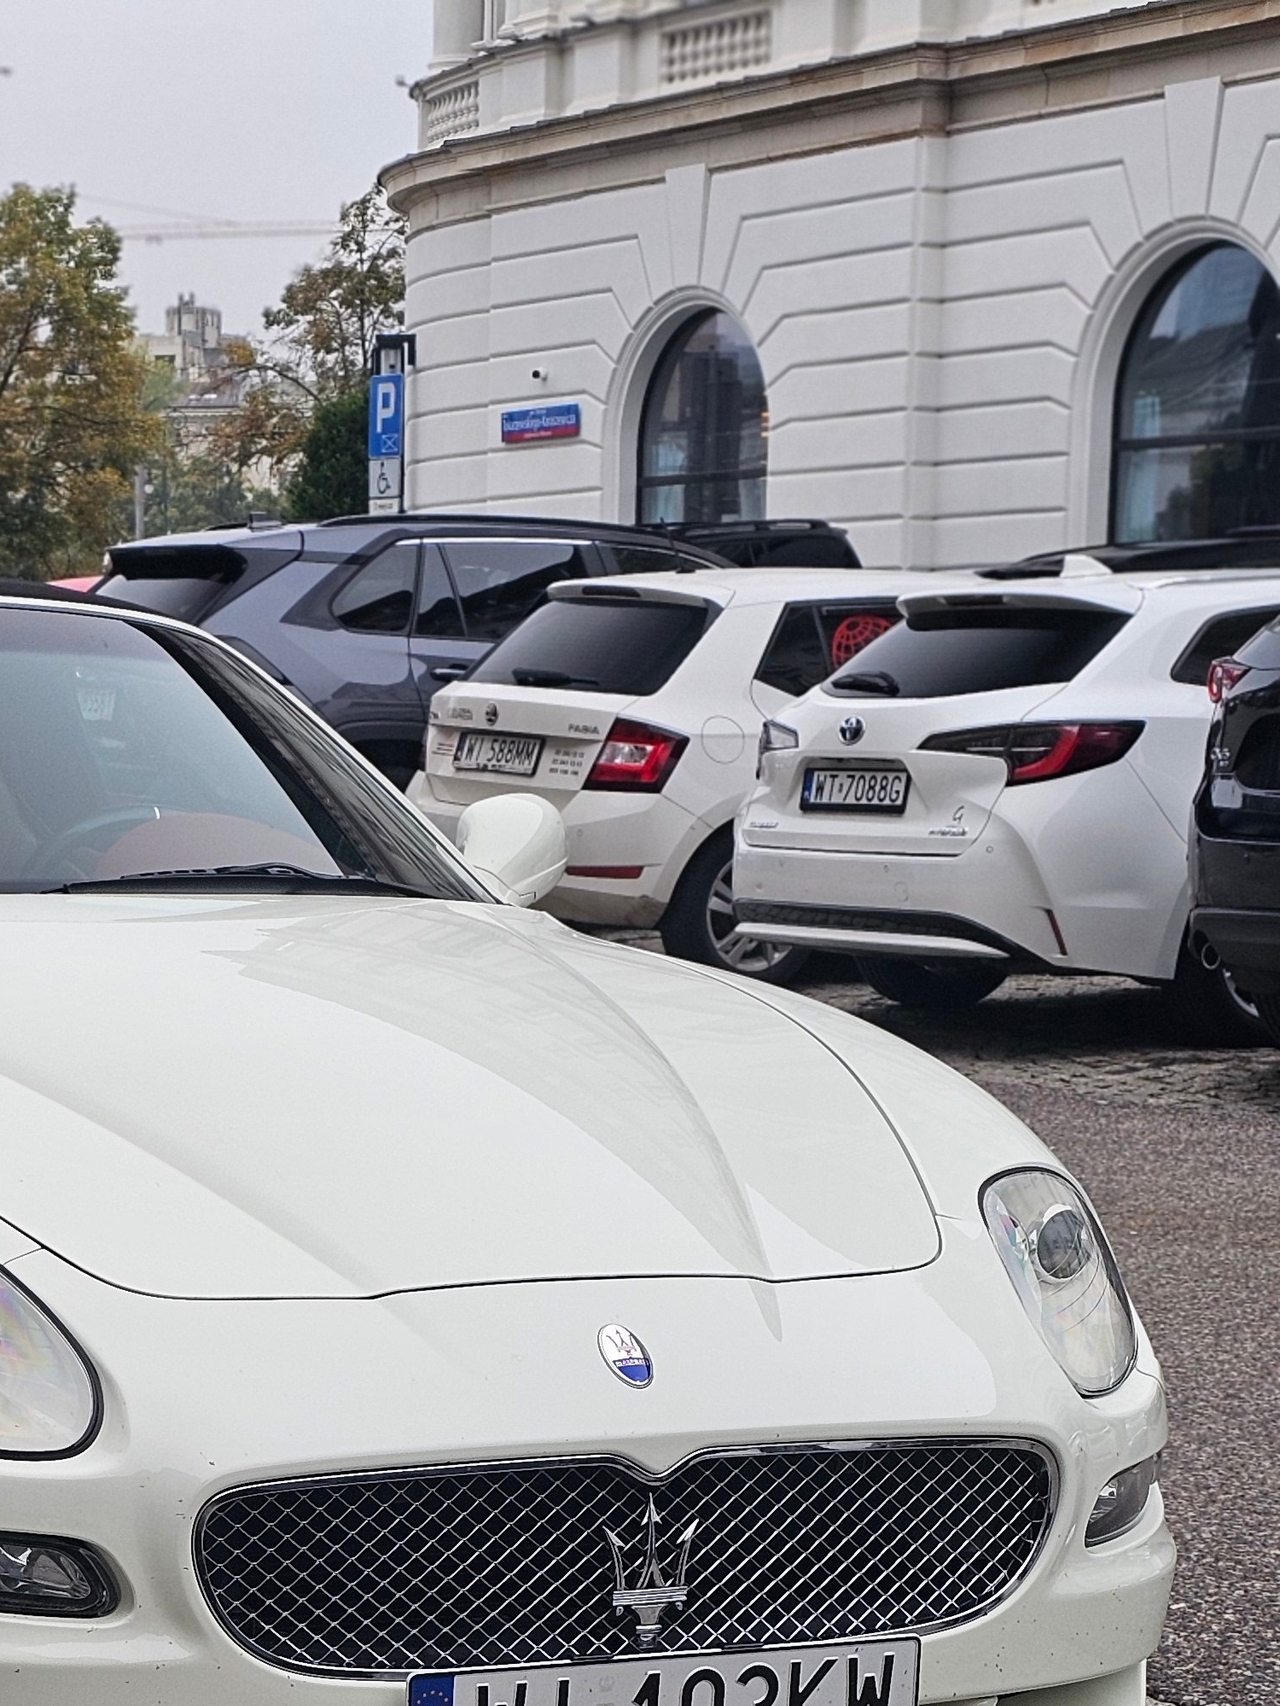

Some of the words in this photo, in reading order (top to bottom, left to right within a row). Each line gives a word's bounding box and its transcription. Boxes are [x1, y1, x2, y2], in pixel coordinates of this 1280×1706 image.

[376, 382, 396, 433] P
[464, 736, 485, 763] WI
[487, 738, 538, 767] 588MM
[814, 773, 839, 801] WT
[842, 774, 902, 804] 7088G
